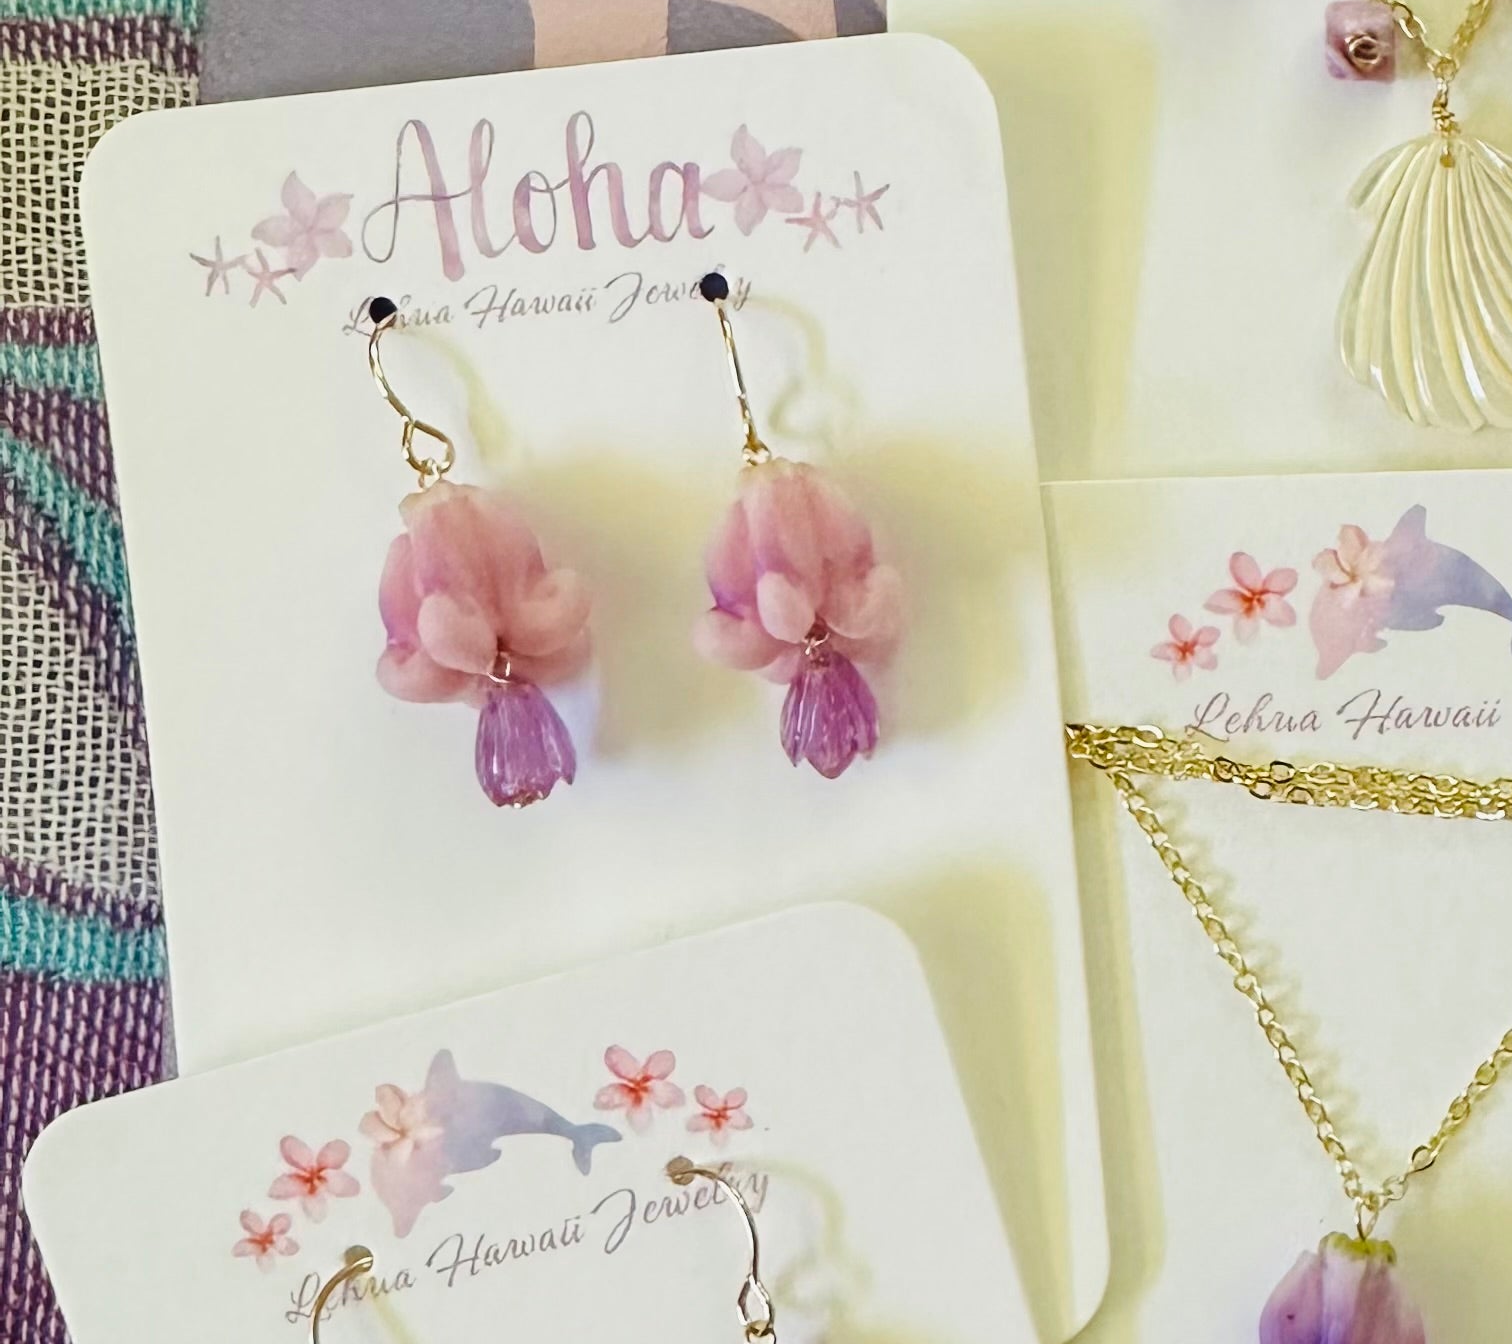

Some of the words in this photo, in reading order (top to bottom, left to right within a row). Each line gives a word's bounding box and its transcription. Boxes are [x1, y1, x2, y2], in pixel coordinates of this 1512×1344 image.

[361, 110, 715, 281] Aloha
[342, 295, 454, 336] Lhua
[463, 284, 598, 329] Hawaii
[1184, 690, 1323, 743] Lehua
[1336, 688, 1500, 740] Hawaii
[425, 1217, 585, 1288] Hawaii
